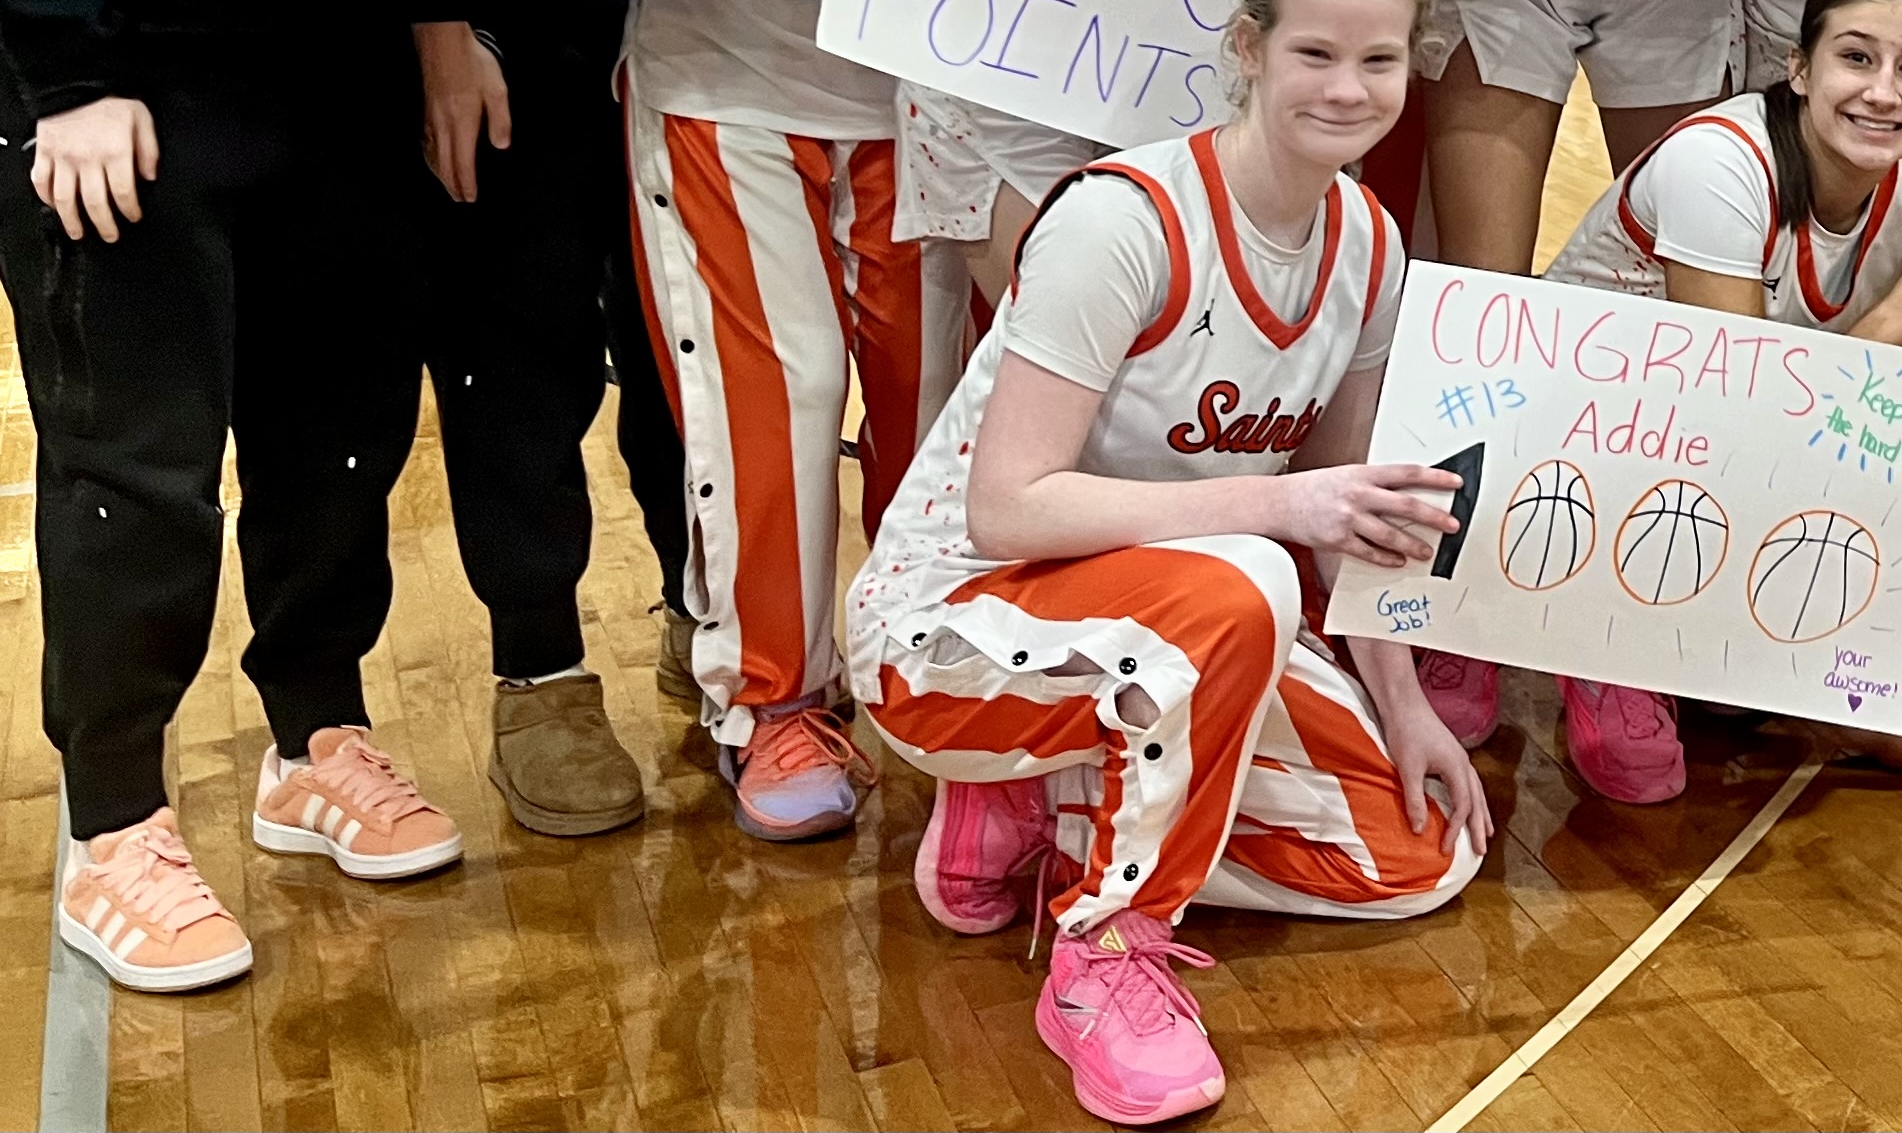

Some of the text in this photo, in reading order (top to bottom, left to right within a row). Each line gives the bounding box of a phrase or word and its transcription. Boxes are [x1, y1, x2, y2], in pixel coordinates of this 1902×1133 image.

[1431, 279, 1817, 417] CONGRATS
[1435, 378, 1529, 433] #13
[1561, 399, 1711, 467] Addie
[1826, 405, 1853, 438] the
[1859, 423, 1902, 463] hard
[1377, 589, 1431, 617] Great
[1833, 645, 1873, 672] your
